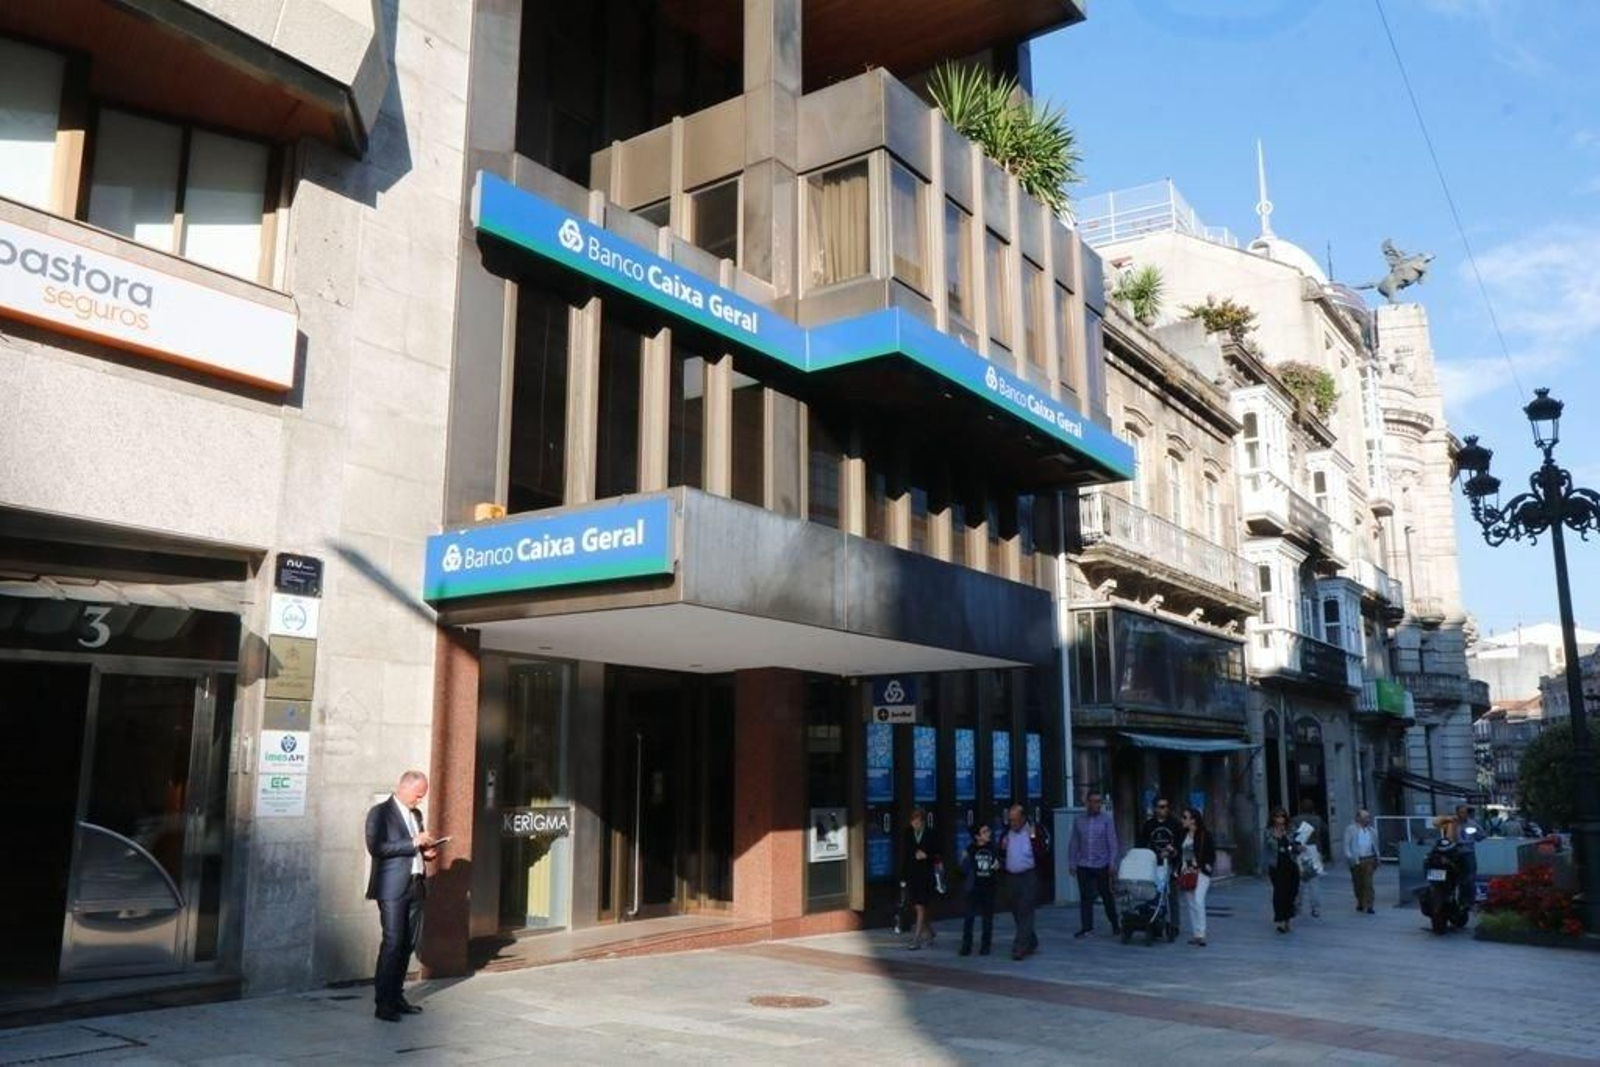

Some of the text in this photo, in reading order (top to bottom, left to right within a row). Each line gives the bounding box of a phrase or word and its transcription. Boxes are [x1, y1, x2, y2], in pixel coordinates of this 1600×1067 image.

[43, 286, 150, 330] seguros
[587, 236, 758, 334] Banco Caixa Geral
[998, 378, 1082, 438] Banco Caixa Geral
[464, 519, 644, 569] Banco Caixa Geral
[77, 605, 112, 645] 3
[503, 812, 568, 832] KERIGMA
